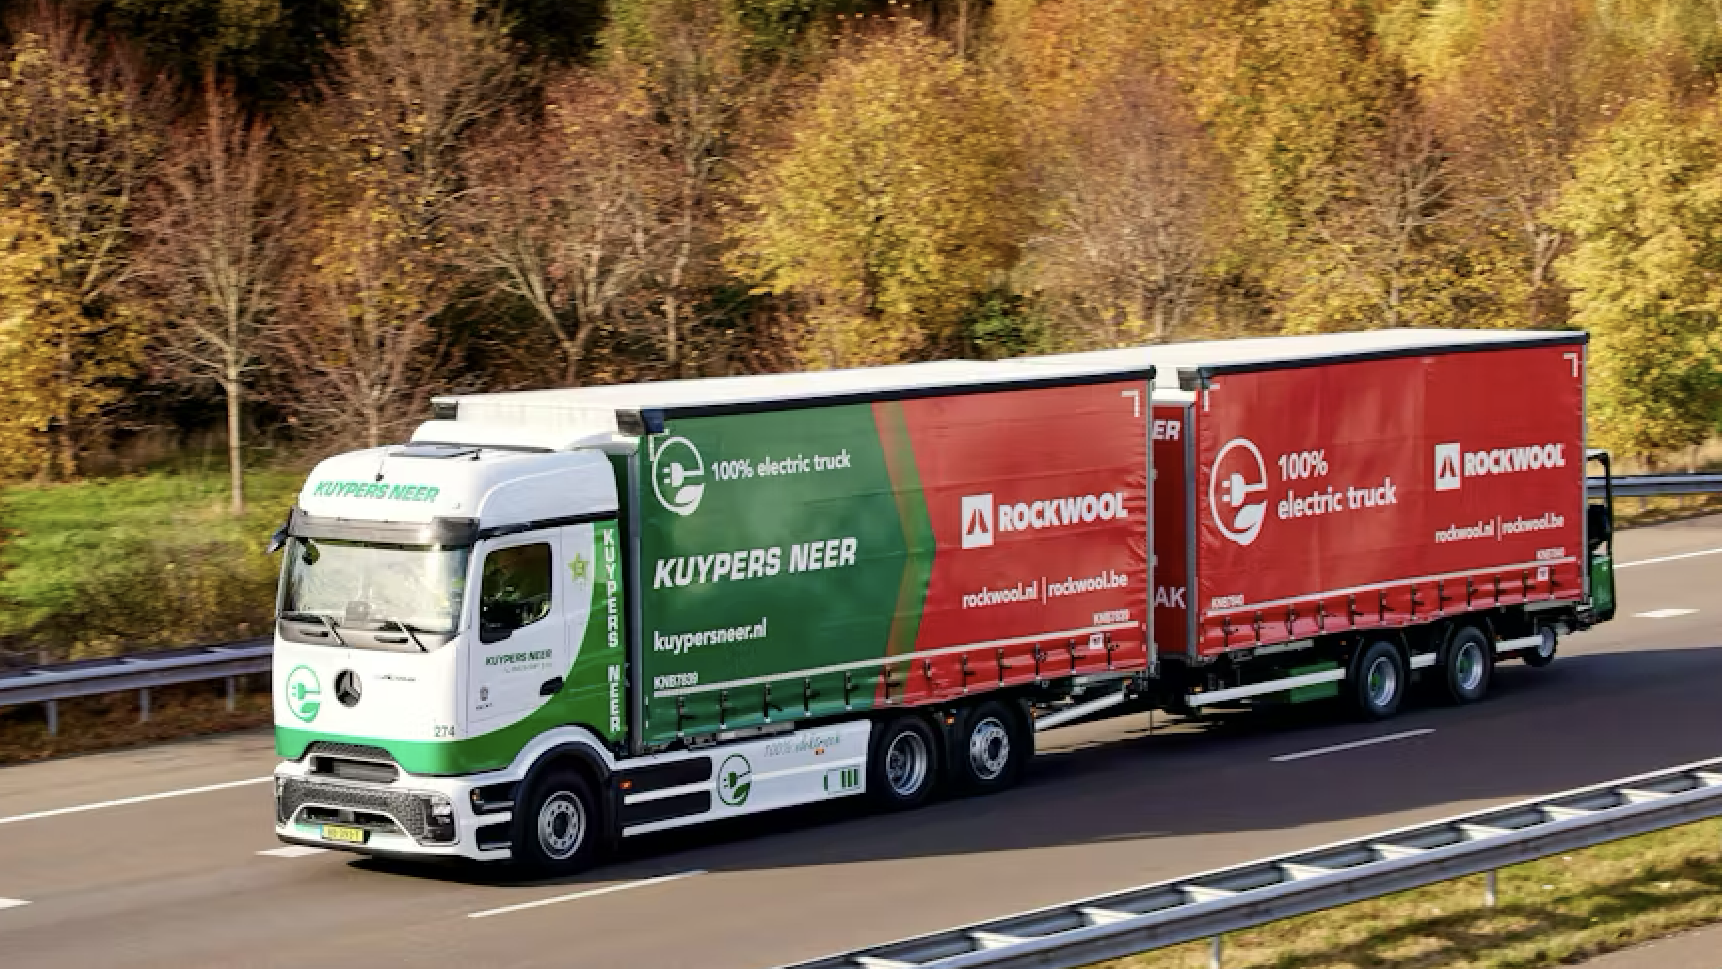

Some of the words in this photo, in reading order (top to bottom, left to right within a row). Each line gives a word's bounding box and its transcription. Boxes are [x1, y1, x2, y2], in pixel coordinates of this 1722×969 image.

[711, 459, 754, 481] 100%
[758, 454, 811, 477] electric
[814, 449, 851, 472] truck
[1278, 449, 1329, 481] 100%
[1464, 442, 1567, 477] ROCKWOOL
[313, 480, 390, 499] KUYPERS
[388, 484, 441, 503] NEER
[1278, 484, 1343, 520] electric
[1347, 476, 1398, 510] truck
[998, 491, 1129, 532] ROCKWOOL
[1434, 518, 1494, 544] rockwool.nl
[1501, 512, 1564, 535] rockwool.be
[653, 547, 781, 590] KUYPERS
[789, 537, 858, 573] NEER
[603, 529, 619, 648] KUYPERS
[962, 580, 1038, 609] rockwool.nl
[1048, 569, 1129, 598] rockwool.be
[653, 616, 766, 655] kuypersneer.nl
[485, 653, 527, 666] KUYPERS
[608, 665, 621, 733] NEER
[434, 724, 455, 738] 274
